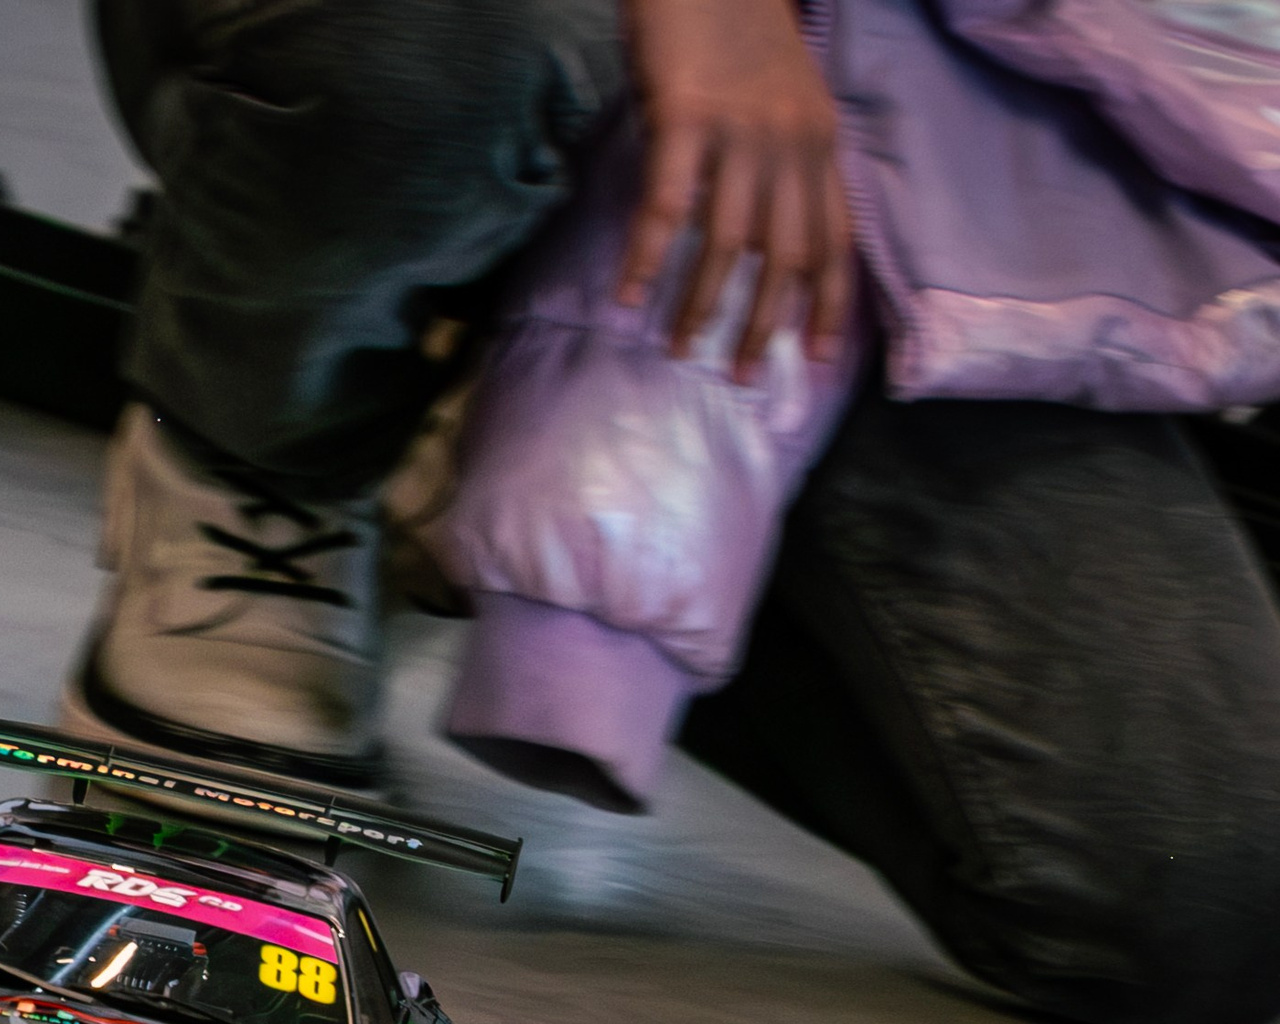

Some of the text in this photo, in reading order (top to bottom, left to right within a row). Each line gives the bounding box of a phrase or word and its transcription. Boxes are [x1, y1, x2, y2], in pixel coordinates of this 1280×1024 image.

[194, 787, 424, 850] Motorsport
[76, 869, 198, 908] RDS
[258, 944, 337, 1005] 88
